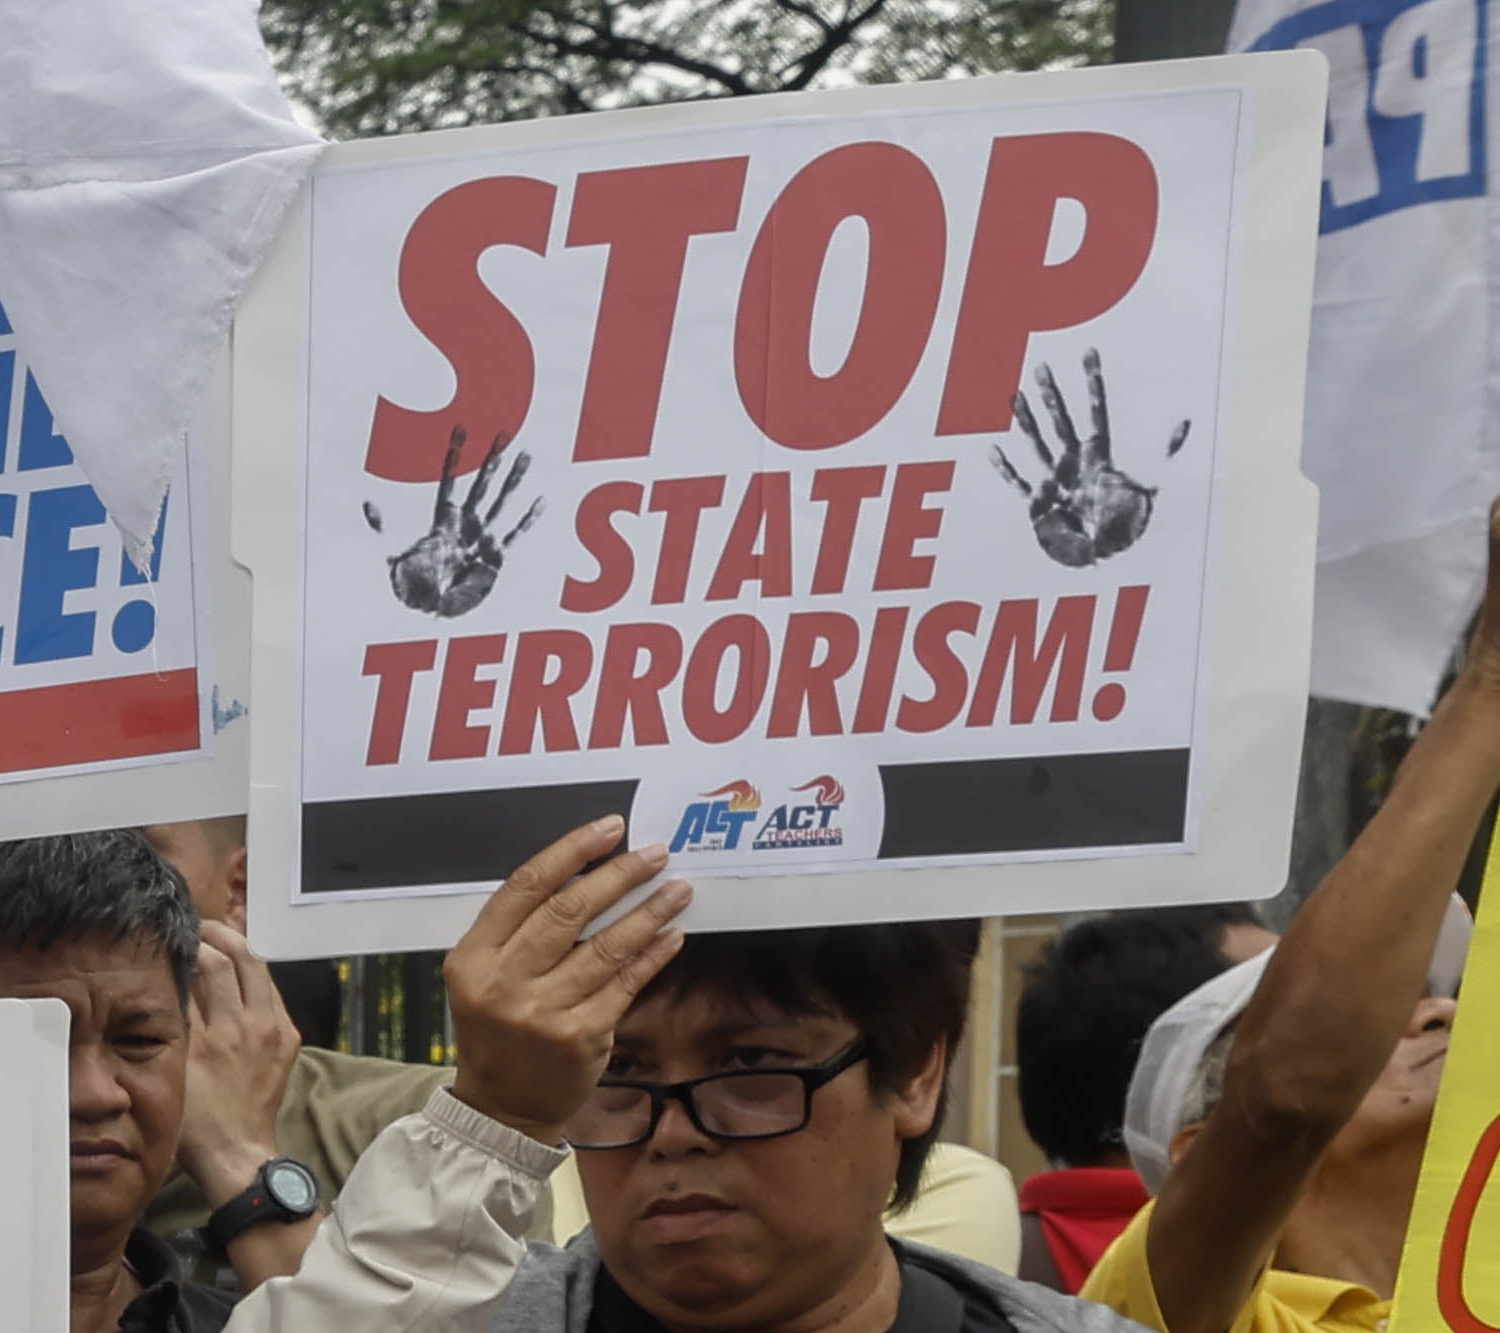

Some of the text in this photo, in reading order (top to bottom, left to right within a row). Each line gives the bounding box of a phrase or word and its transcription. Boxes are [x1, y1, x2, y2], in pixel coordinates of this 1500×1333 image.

[363, 131, 1160, 483] STOP
[558, 458, 956, 615] STATE
[359, 584, 1151, 768] TERRORISM!
[756, 803, 841, 841] ACT
